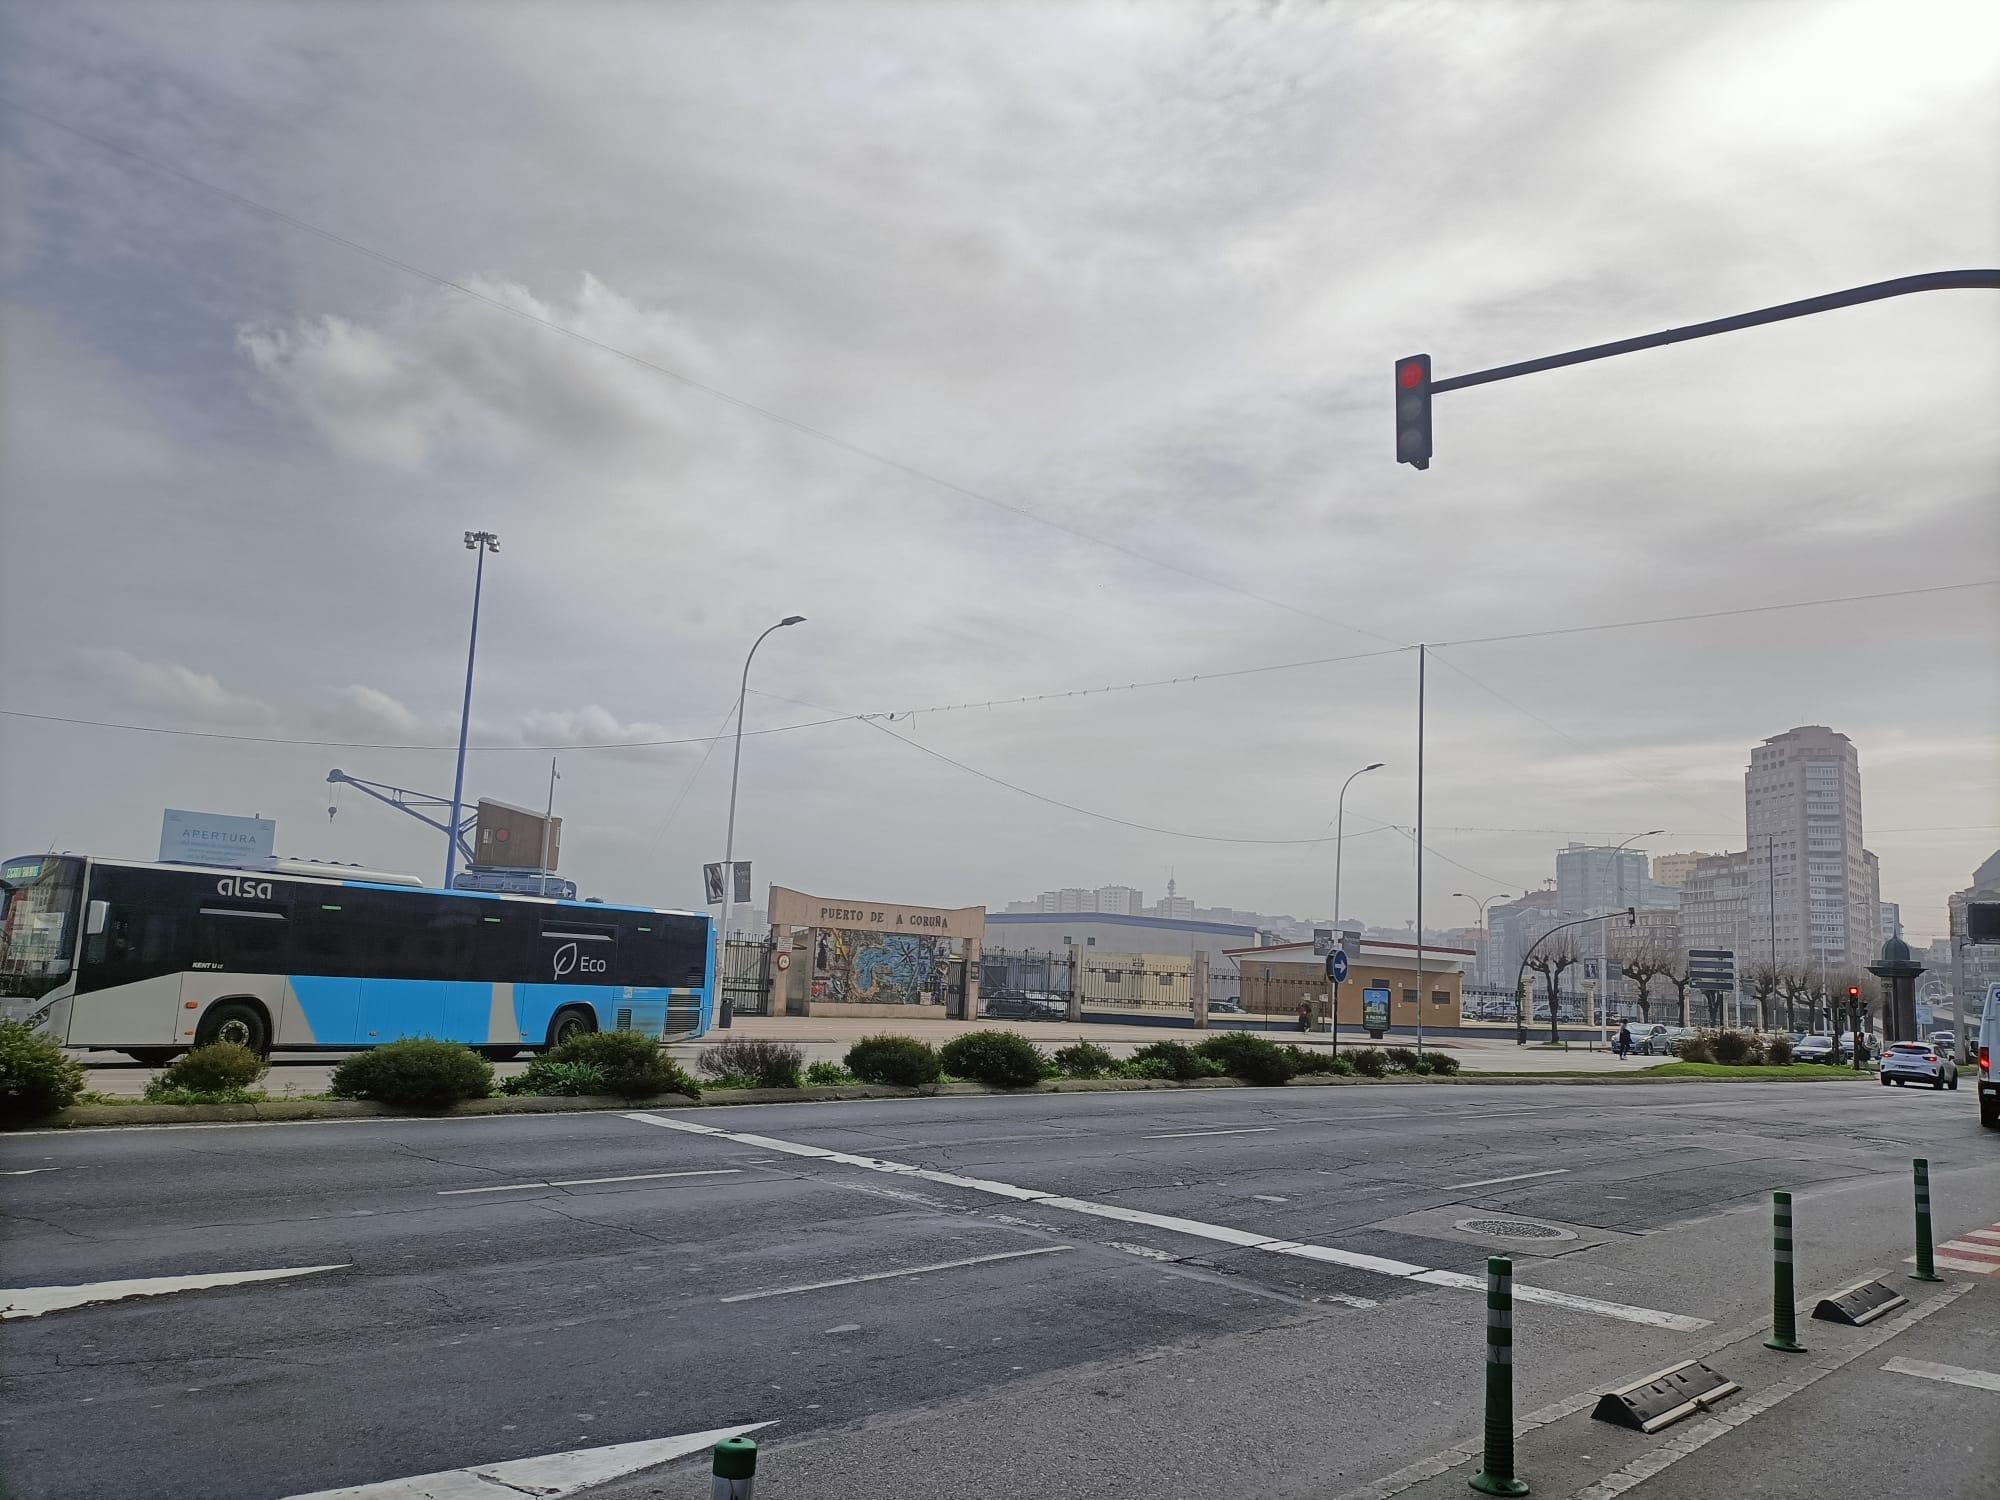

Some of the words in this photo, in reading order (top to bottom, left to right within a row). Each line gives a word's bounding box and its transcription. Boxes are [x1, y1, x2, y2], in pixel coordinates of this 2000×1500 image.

[182, 829, 256, 844] APERTURA
[217, 876, 273, 900] alsa
[821, 908, 864, 921] PUERTO
[870, 912, 885, 923] DE
[896, 914, 904, 925] A
[910, 914, 949, 929] CORUÑA
[581, 956, 606, 973] Eco
